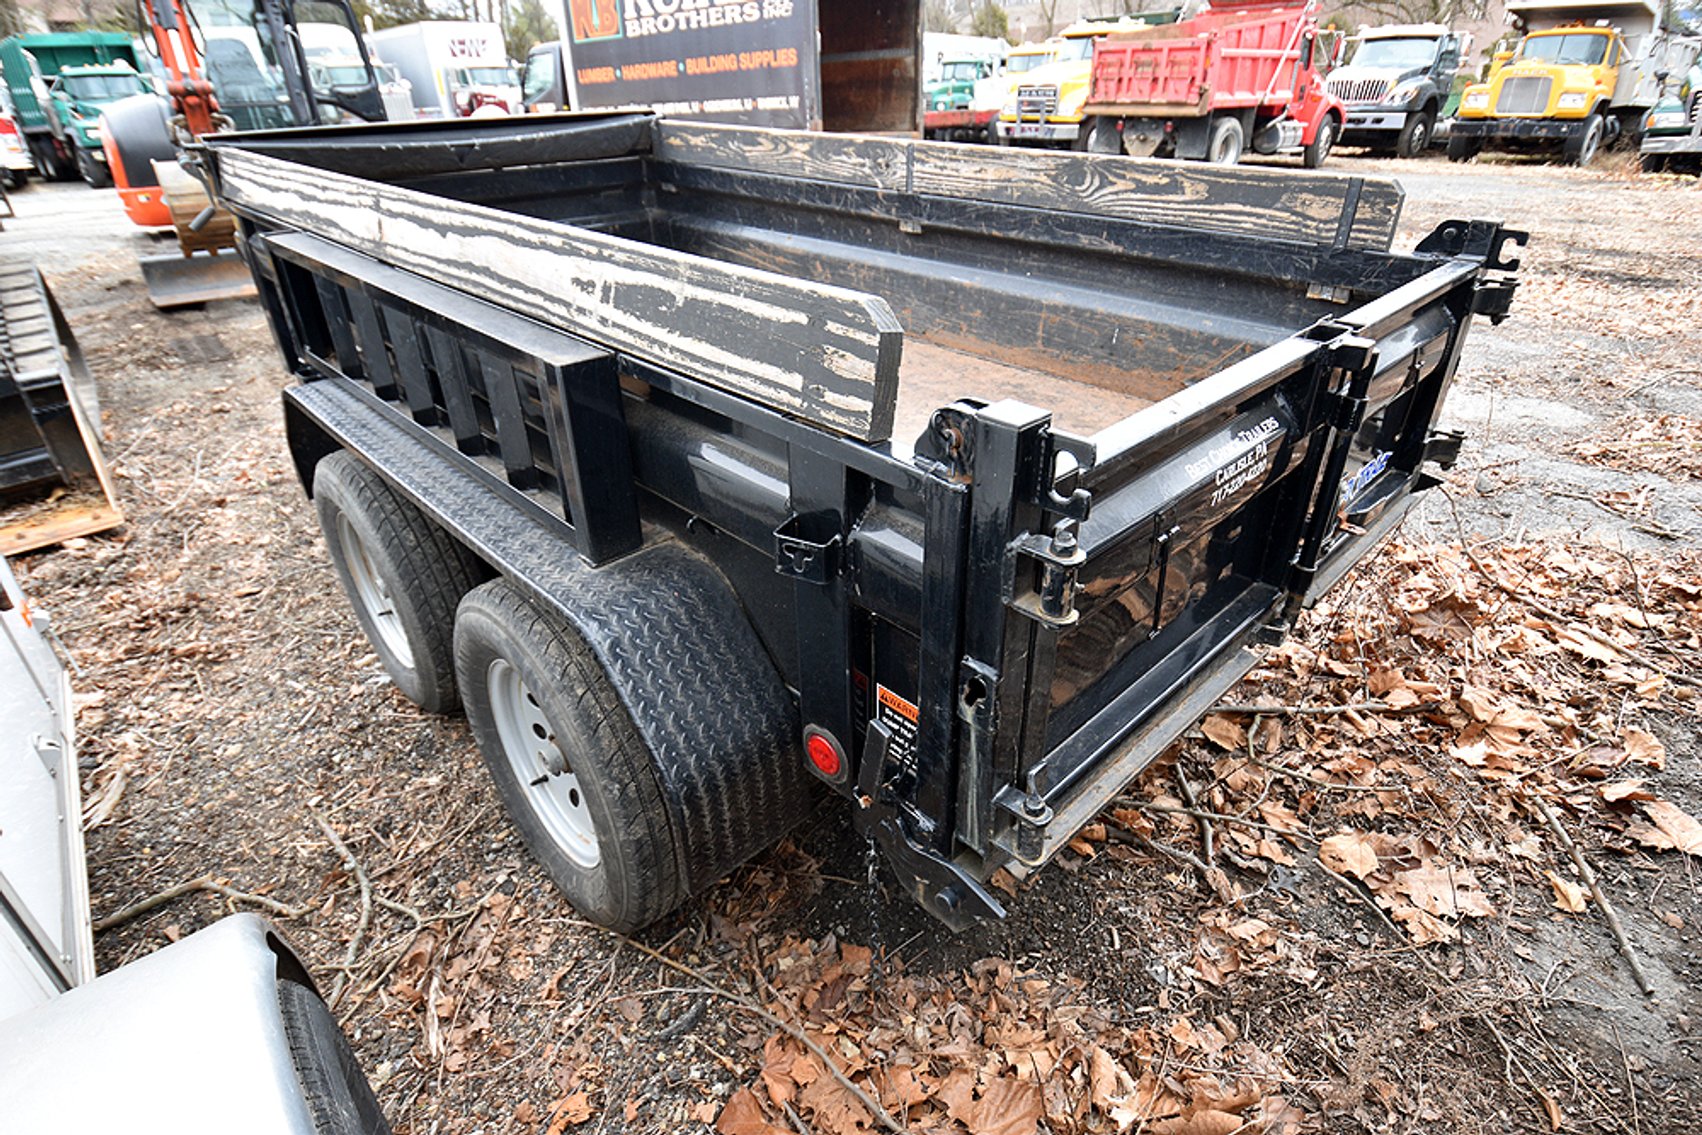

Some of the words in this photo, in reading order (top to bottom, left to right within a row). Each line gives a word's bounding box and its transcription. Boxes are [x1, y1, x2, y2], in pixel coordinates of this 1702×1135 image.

[625, 2, 761, 38] BROTHERS
[577, 66, 617, 85] LUMBER
[621, 60, 679, 81] HARDWARE
[685, 53, 738, 76] BUILDING
[739, 48, 798, 71] SUPPLIES
